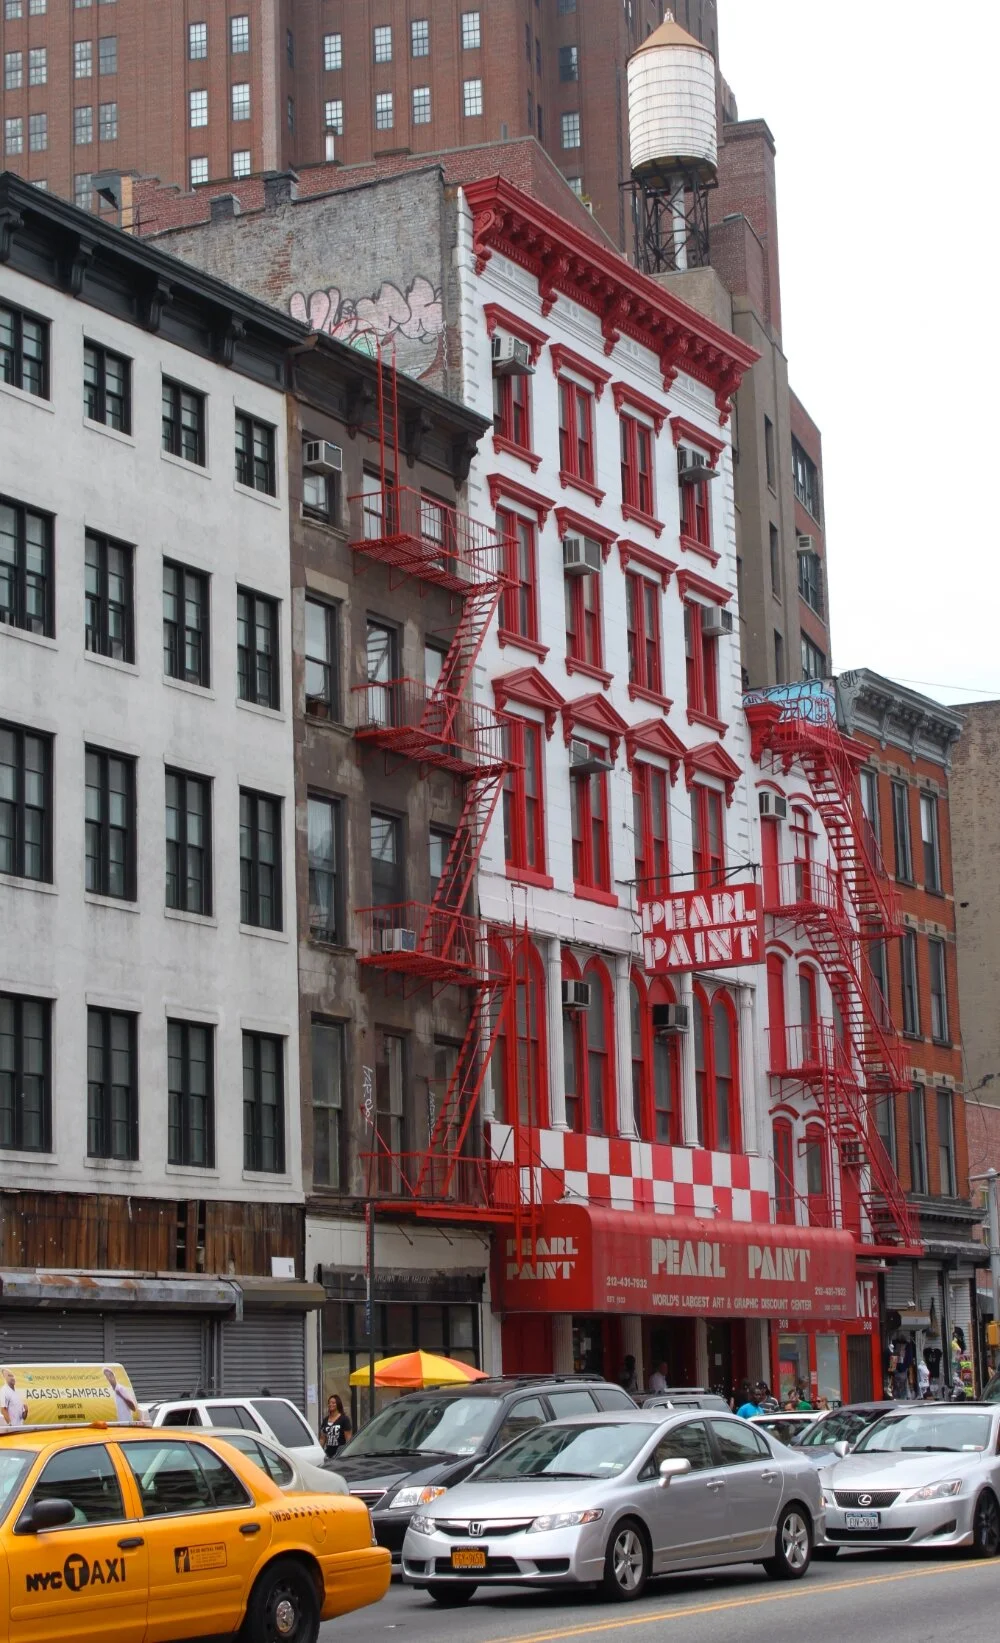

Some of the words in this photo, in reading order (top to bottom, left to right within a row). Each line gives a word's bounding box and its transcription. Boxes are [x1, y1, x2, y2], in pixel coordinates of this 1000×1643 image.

[641, 890, 756, 933] PEARL
[643, 924, 759, 970] PAINT
[506, 1236, 579, 1257] PEARL
[651, 1238, 726, 1279] PEARL
[748, 1245, 810, 1282] PAINT
[506, 1261, 576, 1281] PAINT
[652, 1293, 680, 1307] WORLD'S
[682, 1295, 710, 1309] LARGEST
[712, 1297, 725, 1309] ART
[726, 1299, 732, 1309] &
[734, 1297, 759, 1309] GRAPHIC
[761, 1298, 788, 1310] DISCOUNT
[791, 1299, 812, 1311] CENTER
[26, 1388, 62, 1400] AGASSI
[65, 1387, 111, 1399] SAMPRAS
[26, 1573, 63, 1592] NYC
[64, 1553, 126, 1592] TAXI
